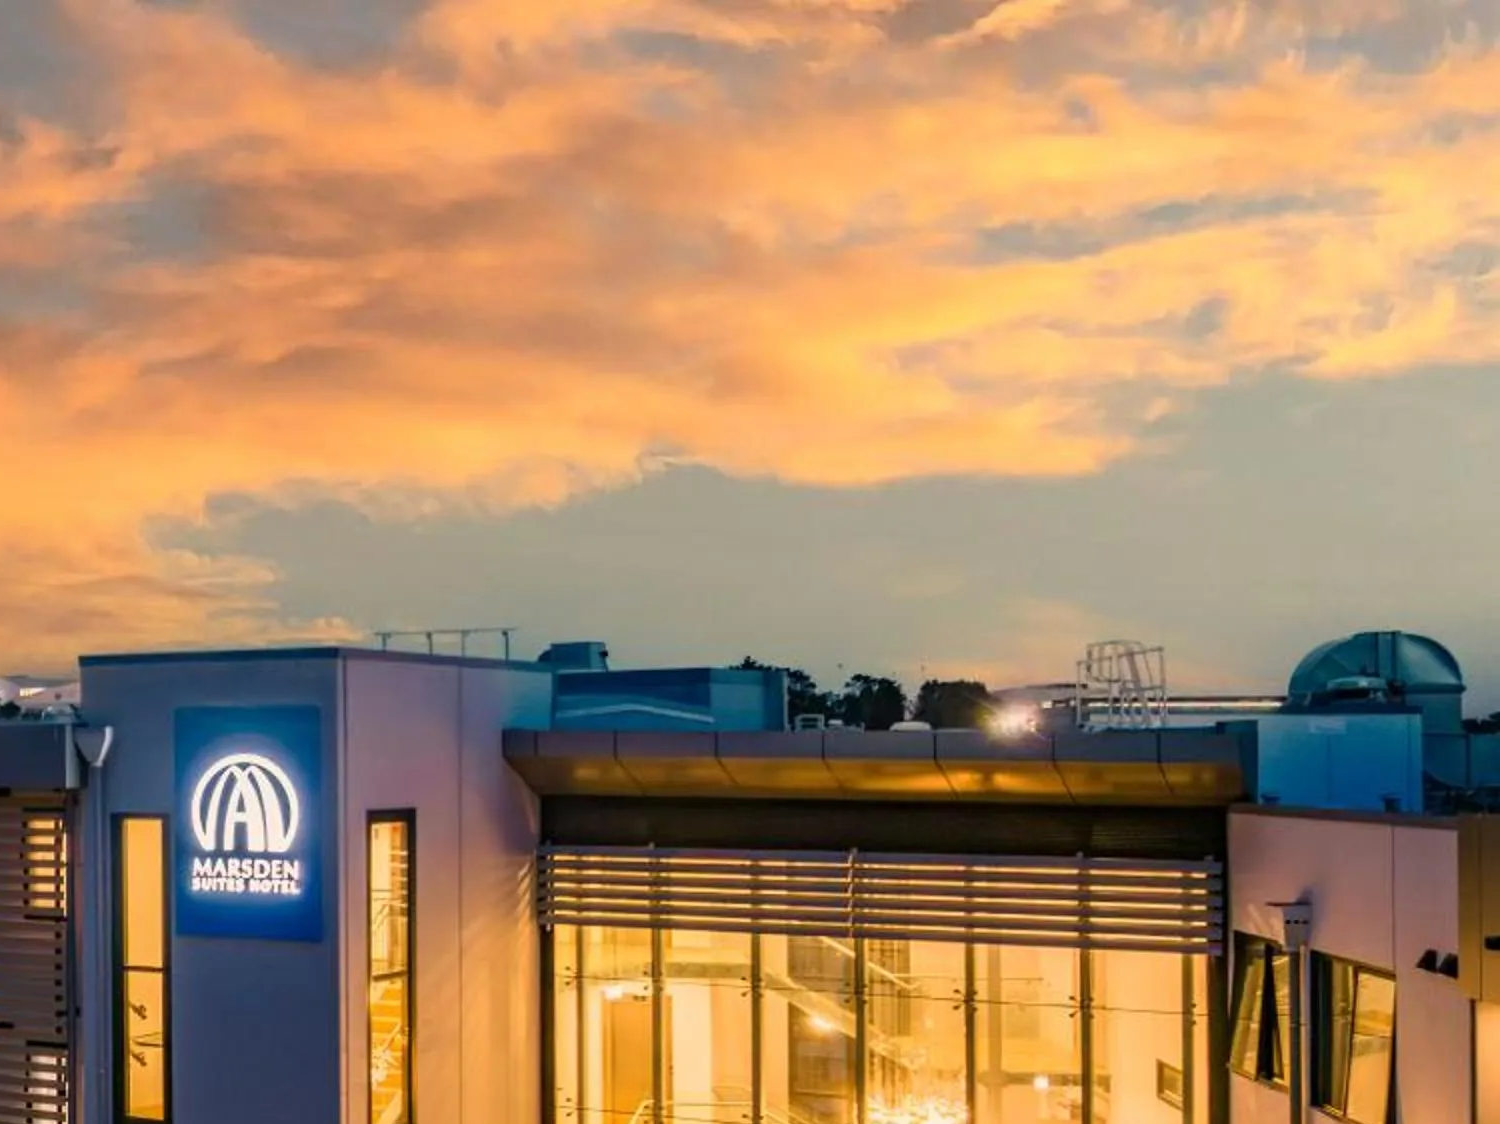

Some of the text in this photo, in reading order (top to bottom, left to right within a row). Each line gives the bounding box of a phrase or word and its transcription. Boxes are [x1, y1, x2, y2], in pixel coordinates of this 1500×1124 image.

[192, 857, 300, 880] MARSDEN
[191, 877, 301, 895] SUITES HOTEL
